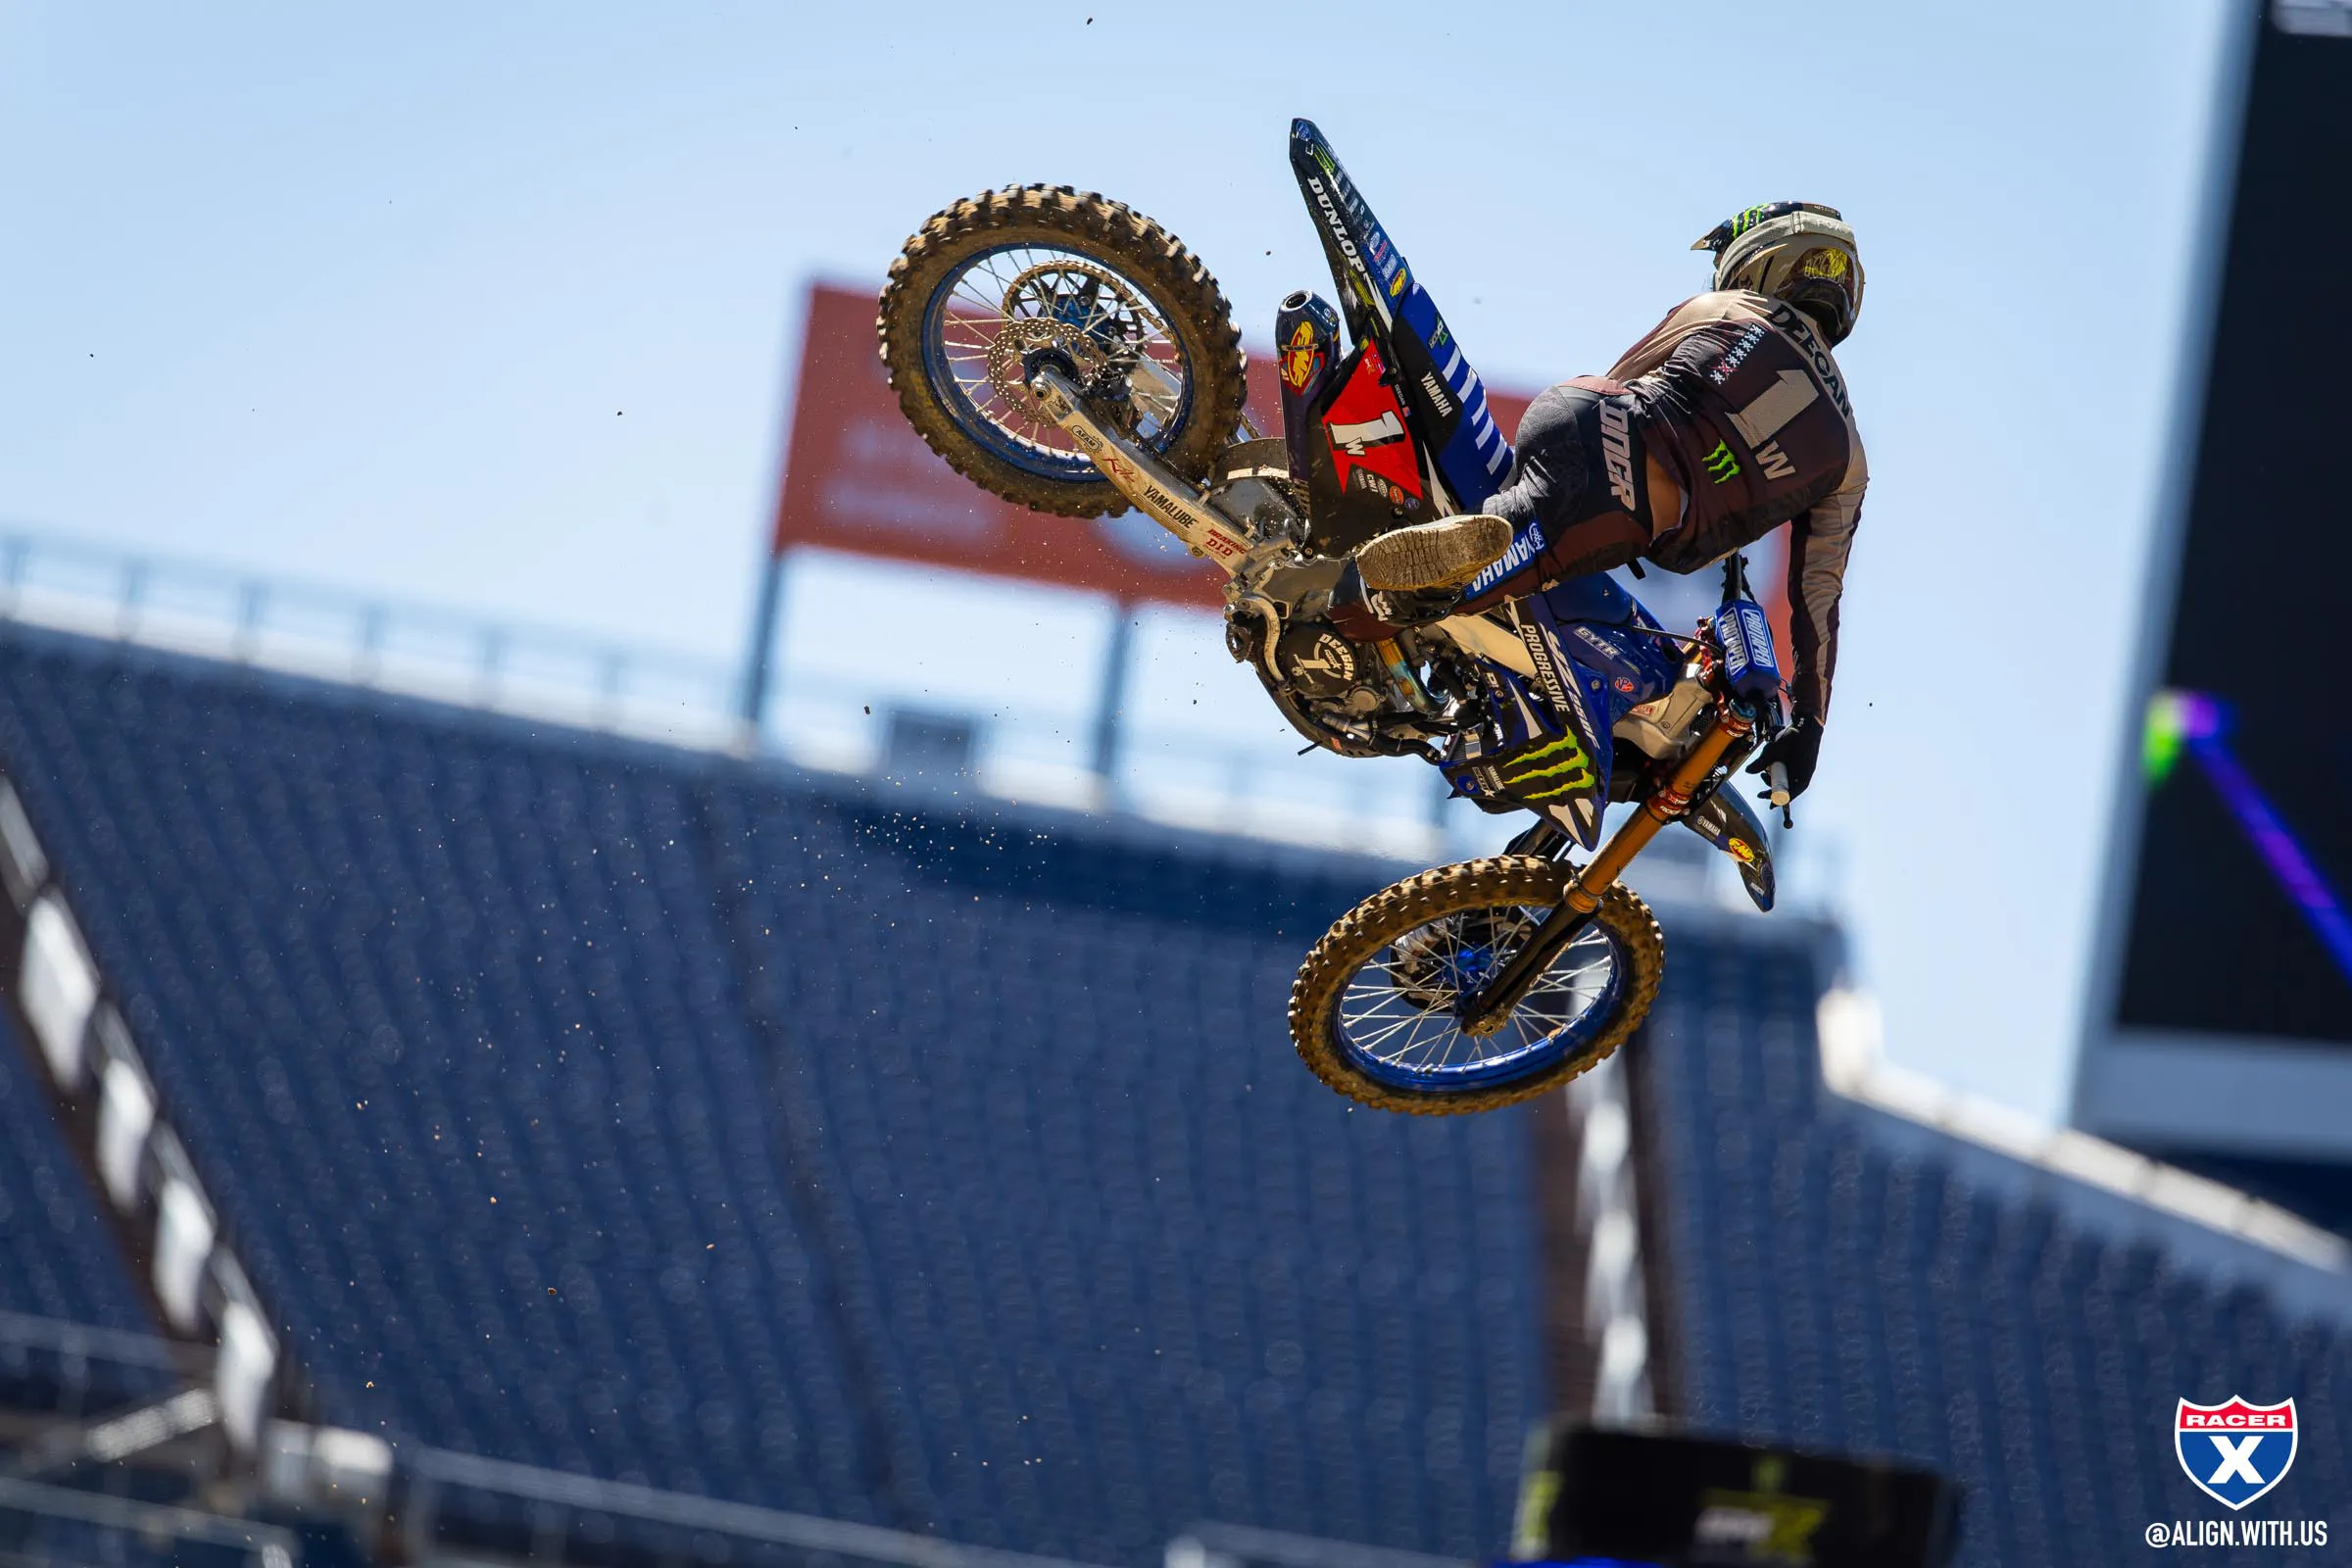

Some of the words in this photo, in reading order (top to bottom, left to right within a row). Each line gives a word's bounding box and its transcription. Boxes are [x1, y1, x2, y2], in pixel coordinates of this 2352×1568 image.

[1307, 176, 1365, 272] DUNLOP
[1421, 371, 1453, 417] YAMAHA
[1725, 368, 1819, 447] 1
[1330, 411, 1405, 446] 1
[1346, 437, 1366, 456] W
[1755, 440, 1796, 480] W
[1144, 485, 1197, 528] YAMALUBE
[1472, 535, 1536, 592] YAMAHA
[1577, 626, 1618, 657] GYTR
[1521, 624, 1571, 712] PROGRESSIVE
[1729, 838, 1755, 862] FMF
